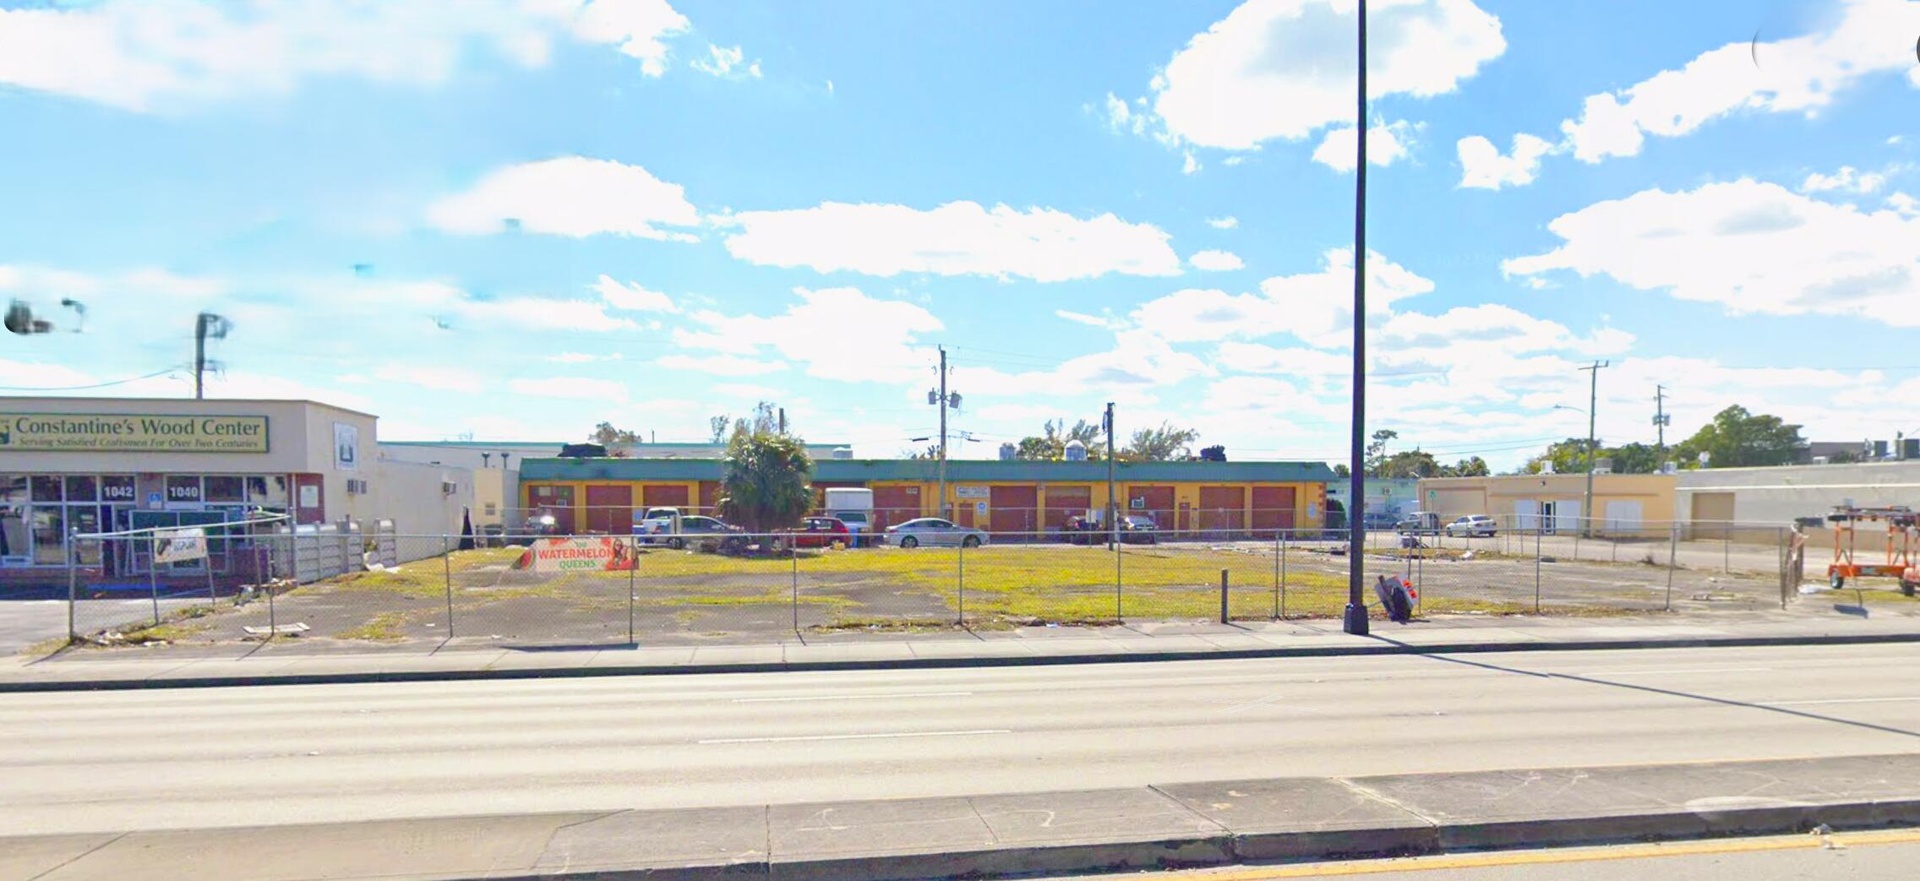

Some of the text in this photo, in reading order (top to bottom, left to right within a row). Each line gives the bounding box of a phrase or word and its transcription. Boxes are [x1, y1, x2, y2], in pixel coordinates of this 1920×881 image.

[16, 417, 260, 436] Constantine's Wood Center
[19, 438, 54, 447] Serving
[150, 439, 166, 447] For
[168, 439, 191, 448] Over
[216, 439, 258, 448] Centuries
[104, 486, 133, 497] 1042
[170, 486, 198, 497] 1040
[539, 549, 615, 559] WATERMELON
[559, 560, 597, 569] QUEENS
